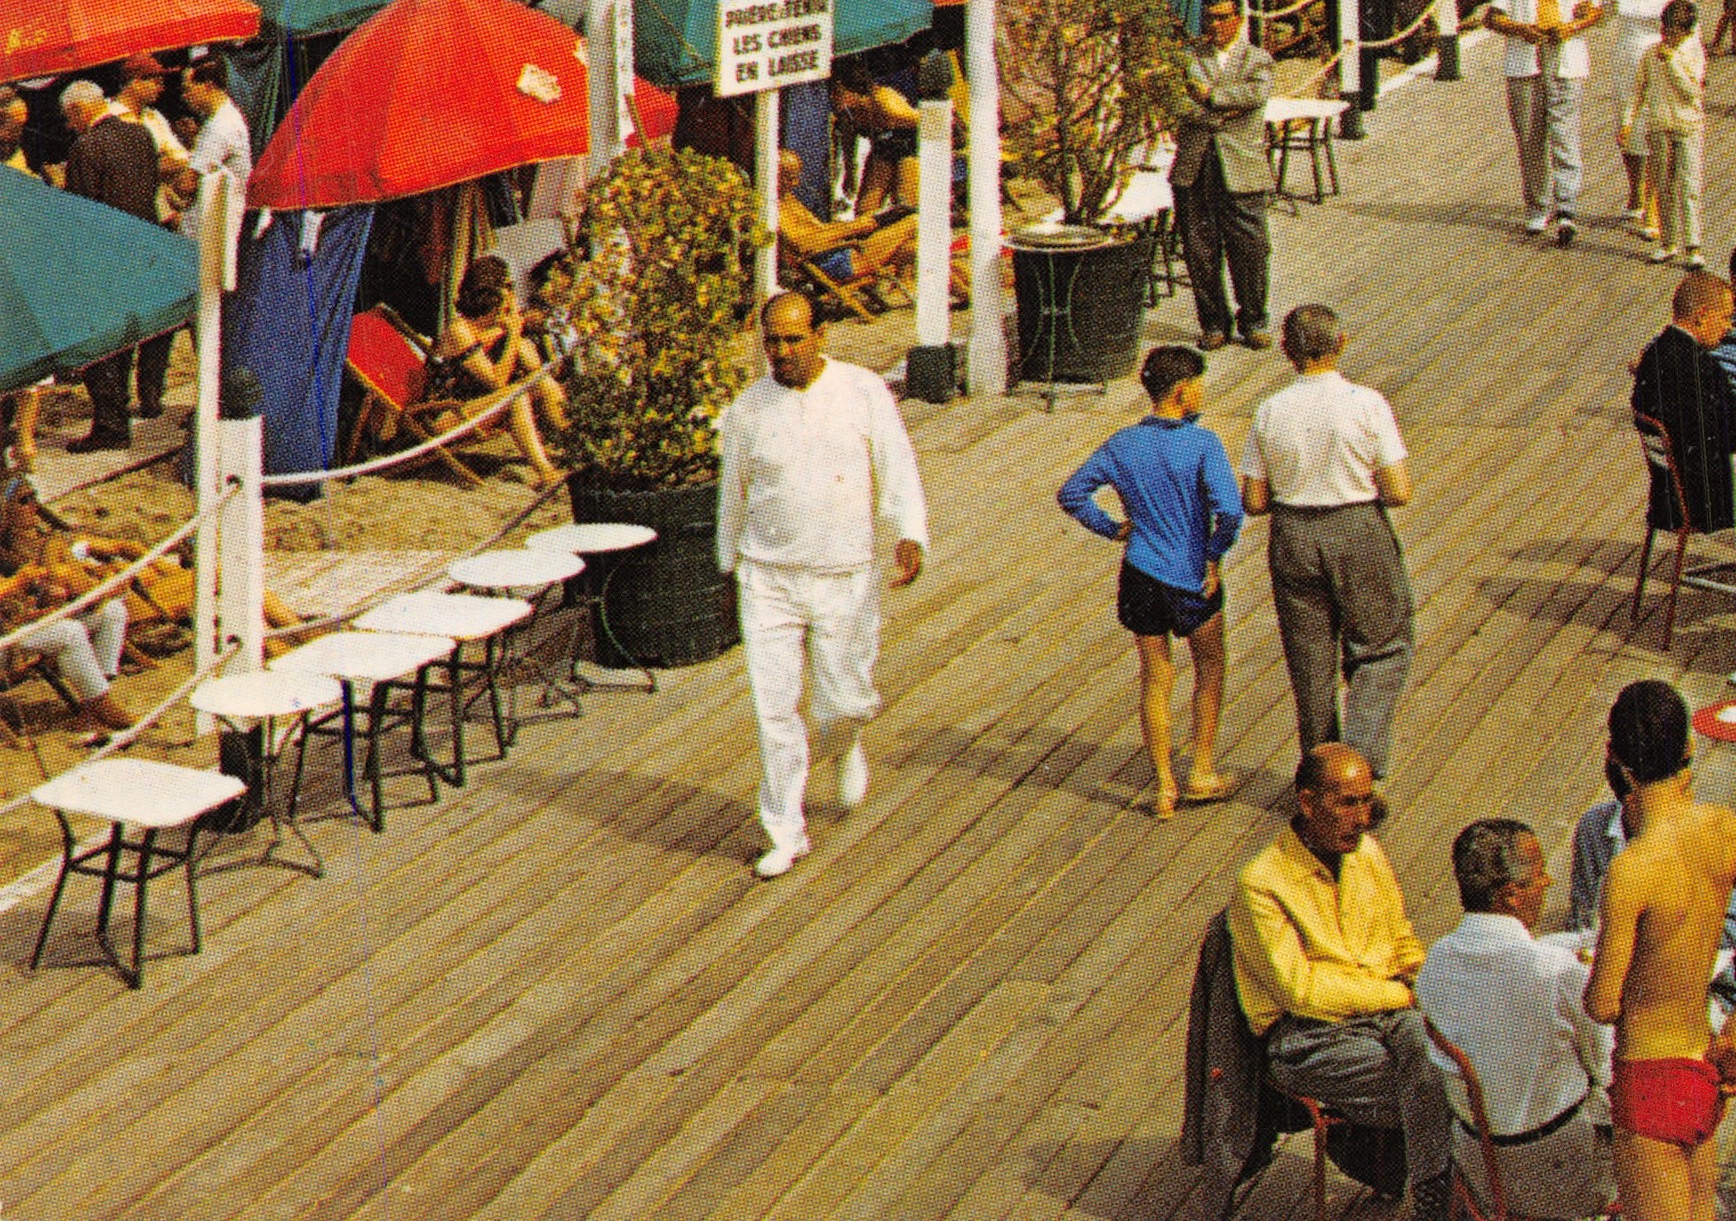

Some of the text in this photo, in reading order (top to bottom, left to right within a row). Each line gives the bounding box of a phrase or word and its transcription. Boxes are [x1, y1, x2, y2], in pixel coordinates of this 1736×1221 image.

[733, 23, 822, 56] LES CHIENS
[736, 49, 819, 83] EN LAISSE
